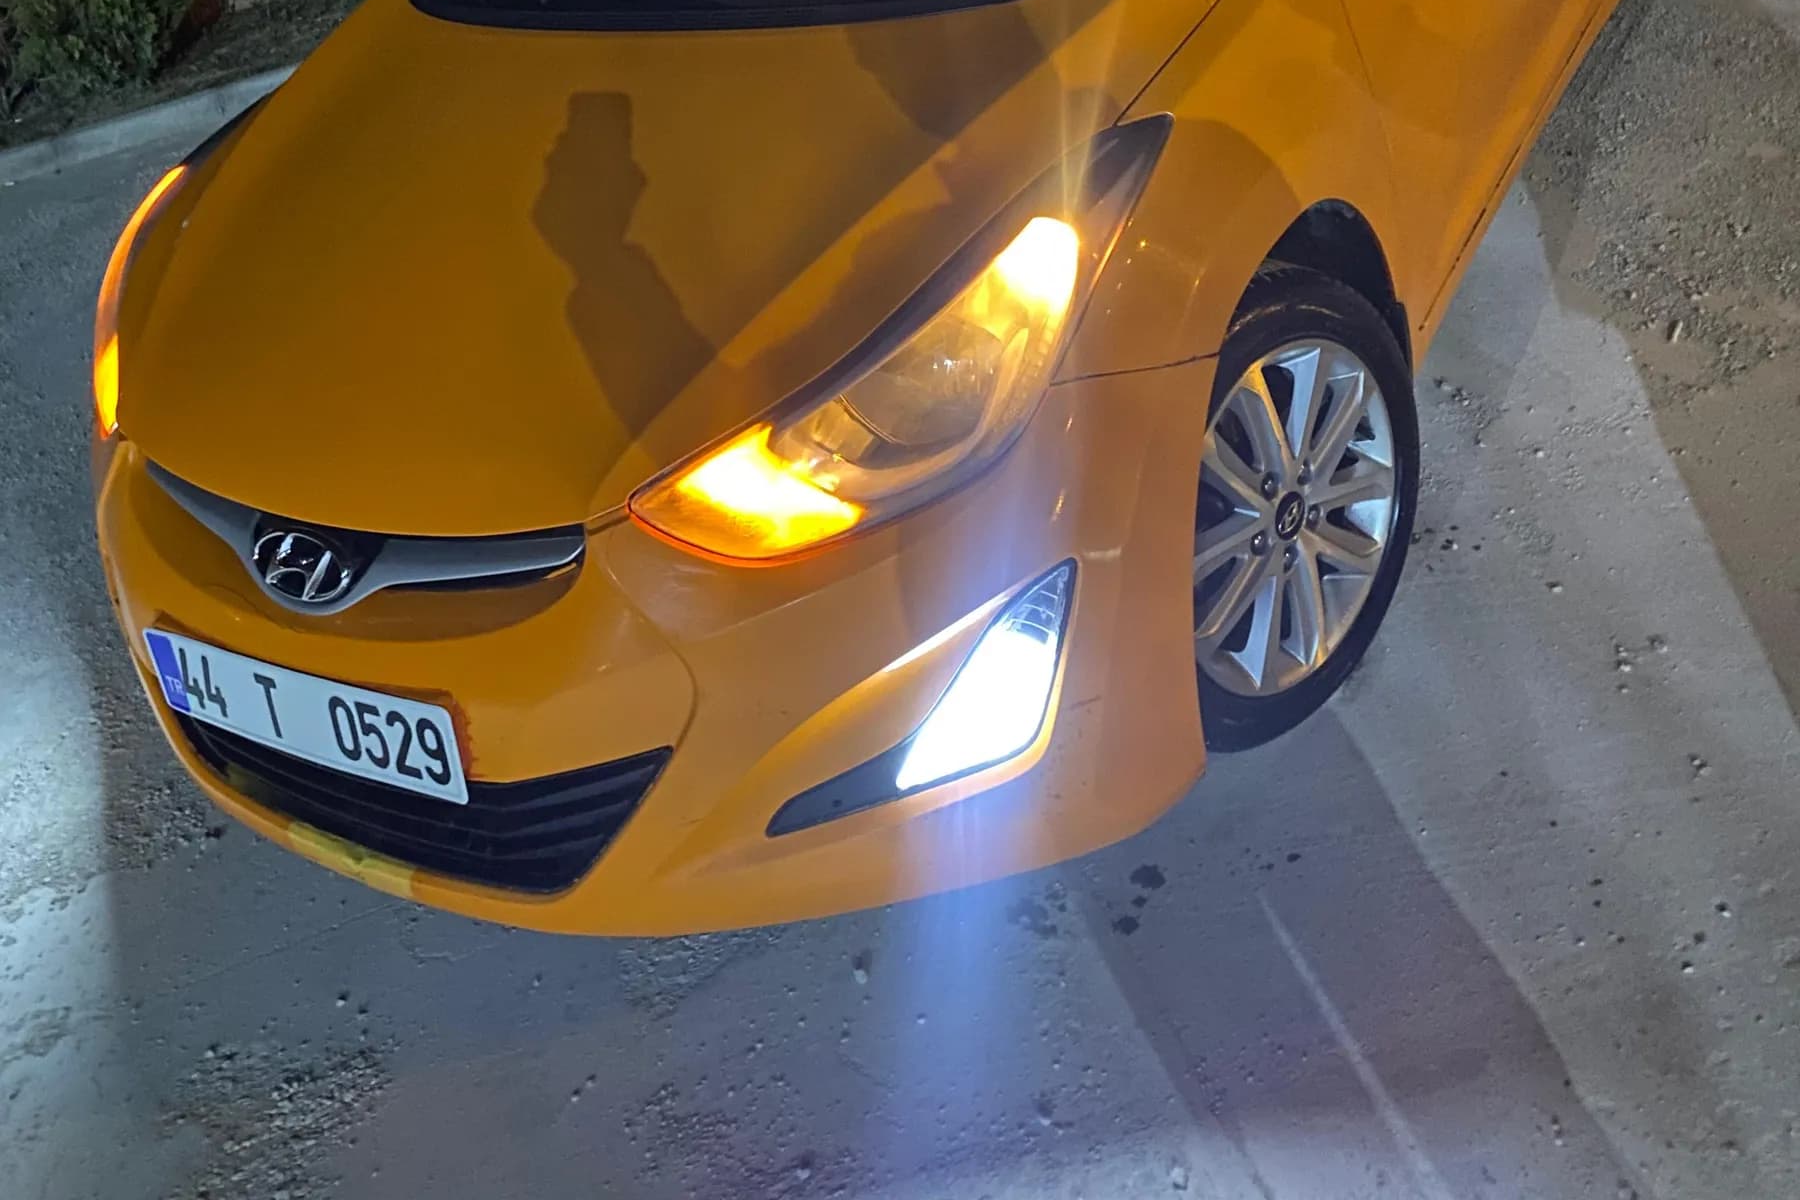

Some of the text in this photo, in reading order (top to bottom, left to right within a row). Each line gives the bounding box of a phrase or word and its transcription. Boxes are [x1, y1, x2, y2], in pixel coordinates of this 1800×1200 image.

[163, 674, 187, 697] TR
[178, 647, 452, 787] 44 T 0529
